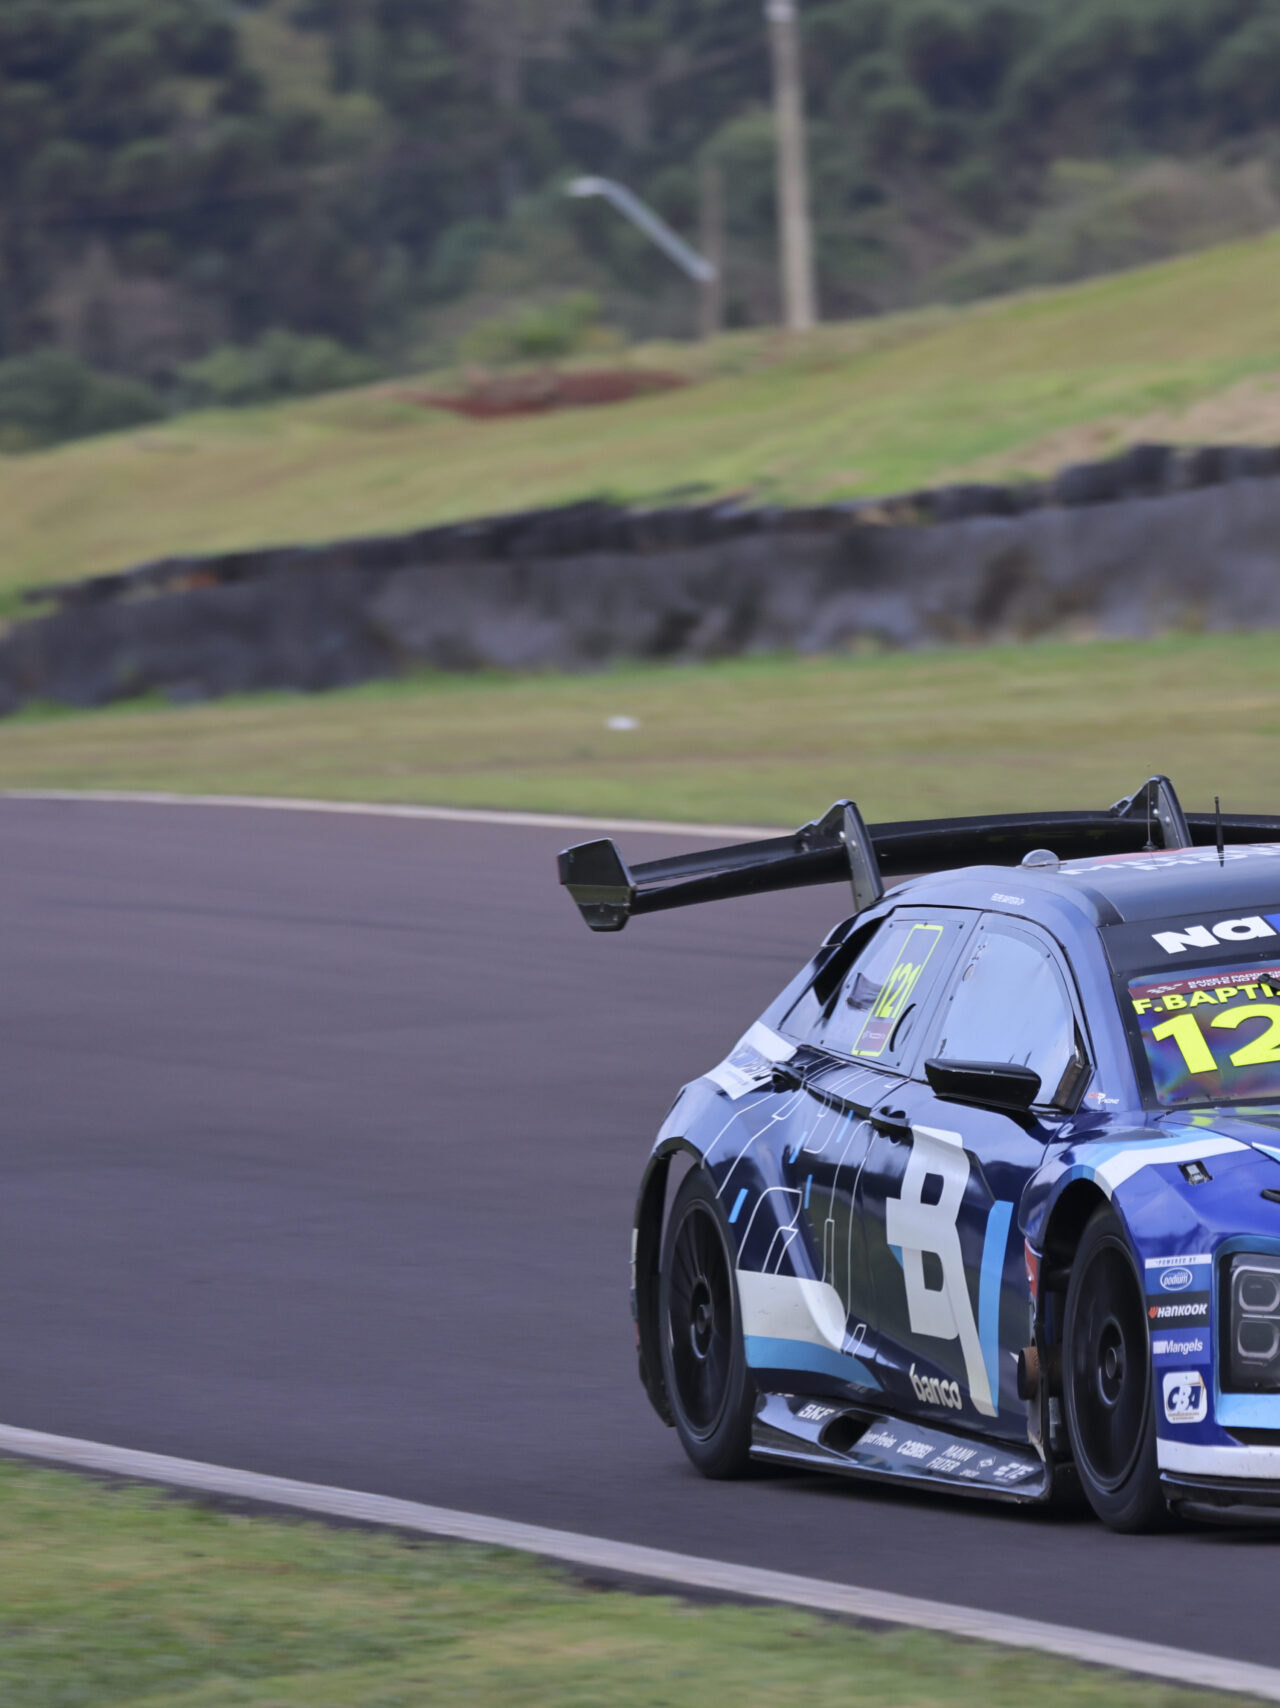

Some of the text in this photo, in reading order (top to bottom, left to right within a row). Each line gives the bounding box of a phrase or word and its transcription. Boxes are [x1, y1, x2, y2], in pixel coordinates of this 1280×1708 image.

[1165, 1338, 1204, 1355] Mangels
[909, 1363, 963, 1410] banco
[1168, 1385, 1201, 1410] CBA
[798, 1403, 836, 1421] SKF
[941, 1445, 978, 1462] MANN
[926, 1457, 961, 1472] FILTER
